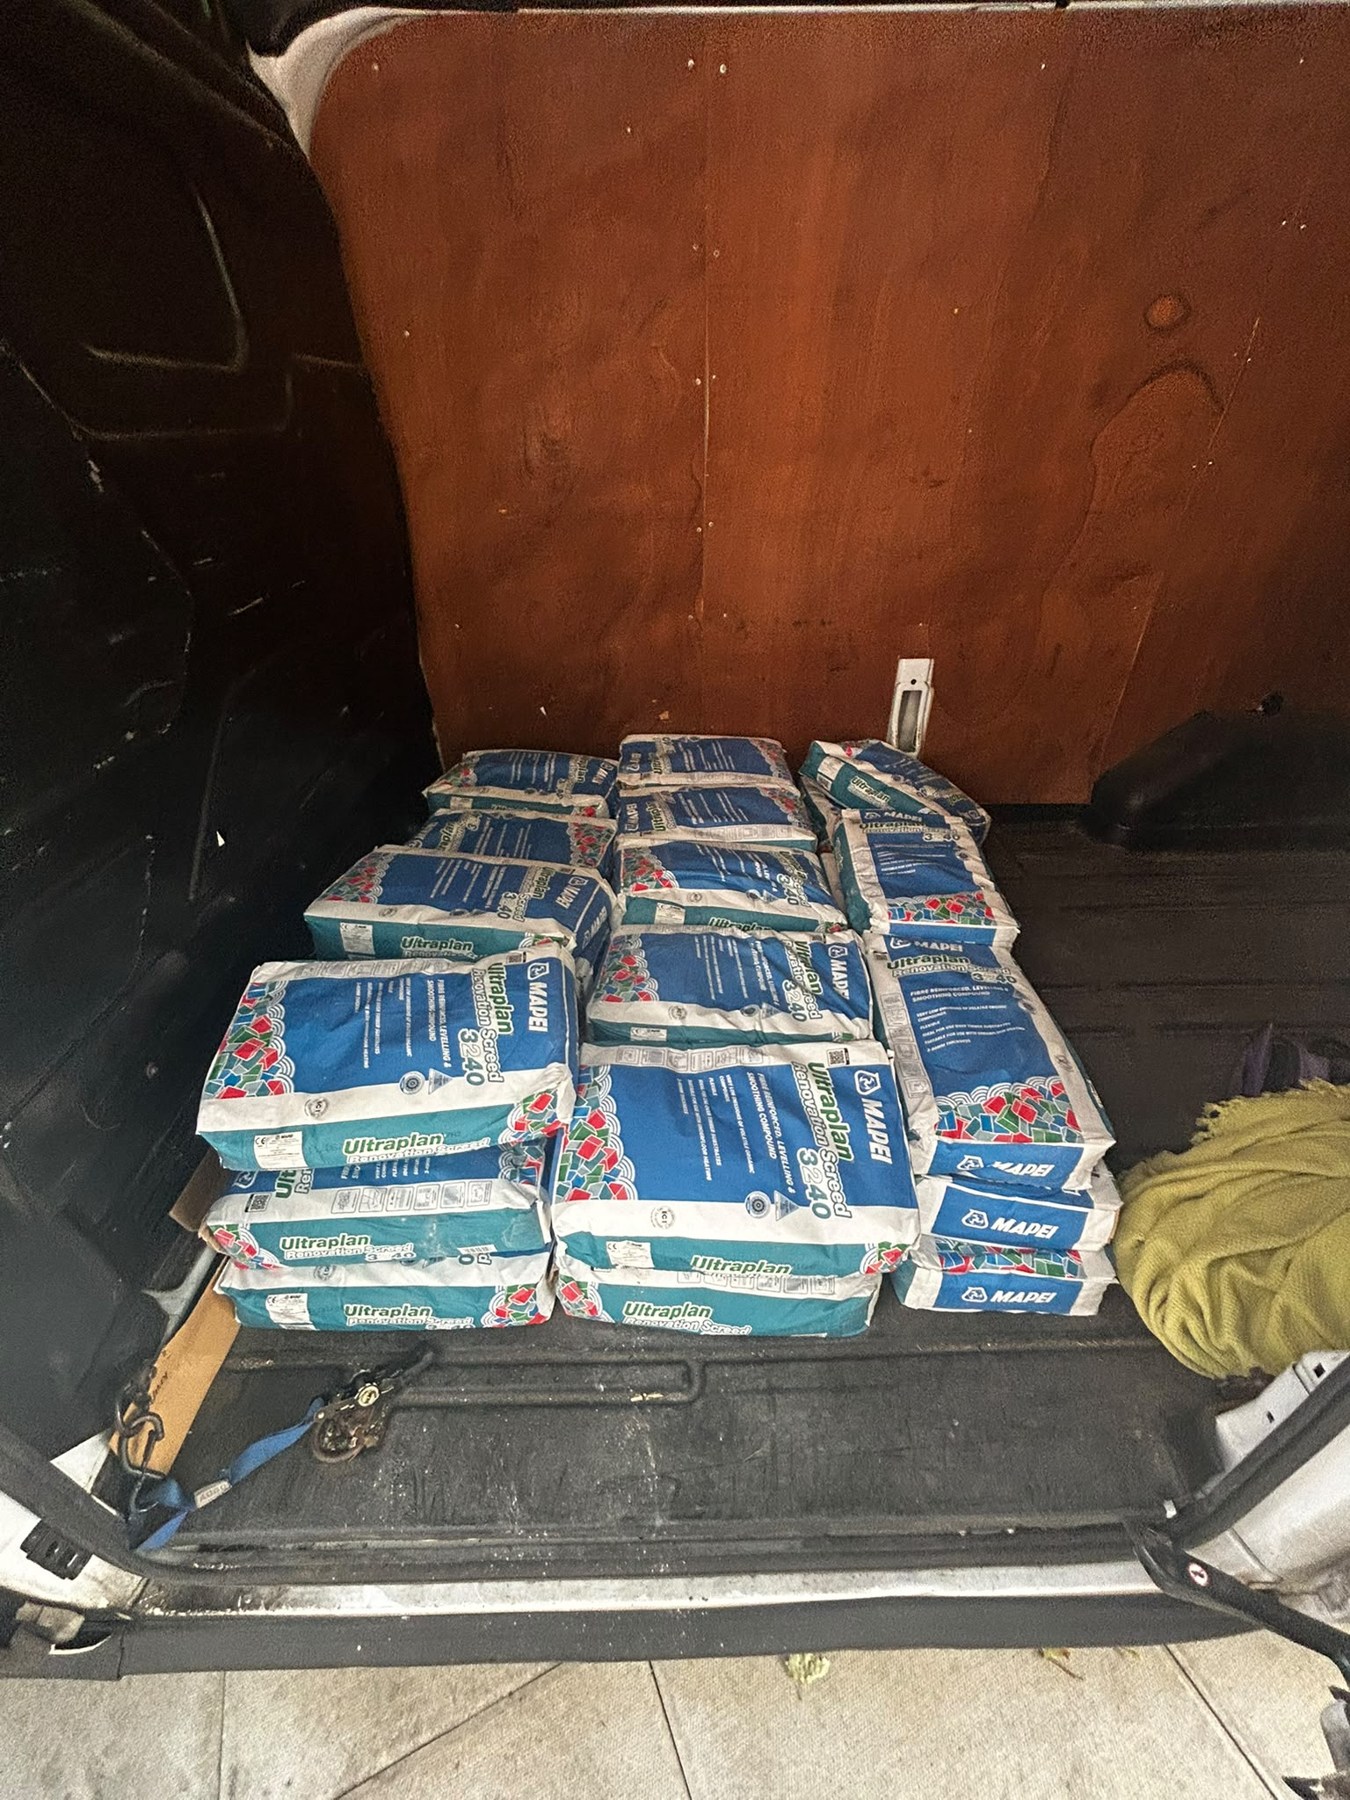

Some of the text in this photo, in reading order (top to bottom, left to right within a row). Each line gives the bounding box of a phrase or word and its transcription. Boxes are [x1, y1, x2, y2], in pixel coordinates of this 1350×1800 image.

[400, 936, 474, 951] Ultraplan
[914, 941, 963, 952] MAPEI
[887, 955, 970, 969] Ultraplan
[488, 962, 515, 1035] Ultraplan
[528, 982, 549, 1032] MAPEI
[784, 980, 807, 1022] 3240
[440, 1025, 451, 1061] LEVELLING
[458, 1028, 485, 1086] 3240
[481, 1027, 505, 1083] Screed
[747, 1072, 776, 1159] SMOOTHING COMPOUND
[808, 1062, 854, 1161] Ultraplan
[791, 1061, 852, 1218] Renovation Screed
[862, 1098, 892, 1164] MAPEI
[343, 1132, 444, 1155] Ultraplan
[347, 1147, 434, 1163] Renovation
[777, 1140, 793, 1186] LEVELLING
[797, 1147, 832, 1220] 3240
[991, 1217, 1059, 1239] MAPEI
[280, 1233, 370, 1251] Ultraplan
[285, 1247, 362, 1260] Renovation
[686, 1255, 793, 1275] Ultraplan
[990, 1290, 1057, 1304] MAPEI
[343, 1303, 433, 1318] Ultraplan
[347, 1316, 424, 1326] Renovation
[623, 1301, 713, 1320] Ultraplan
[623, 1318, 752, 1335] Renovation Screed
